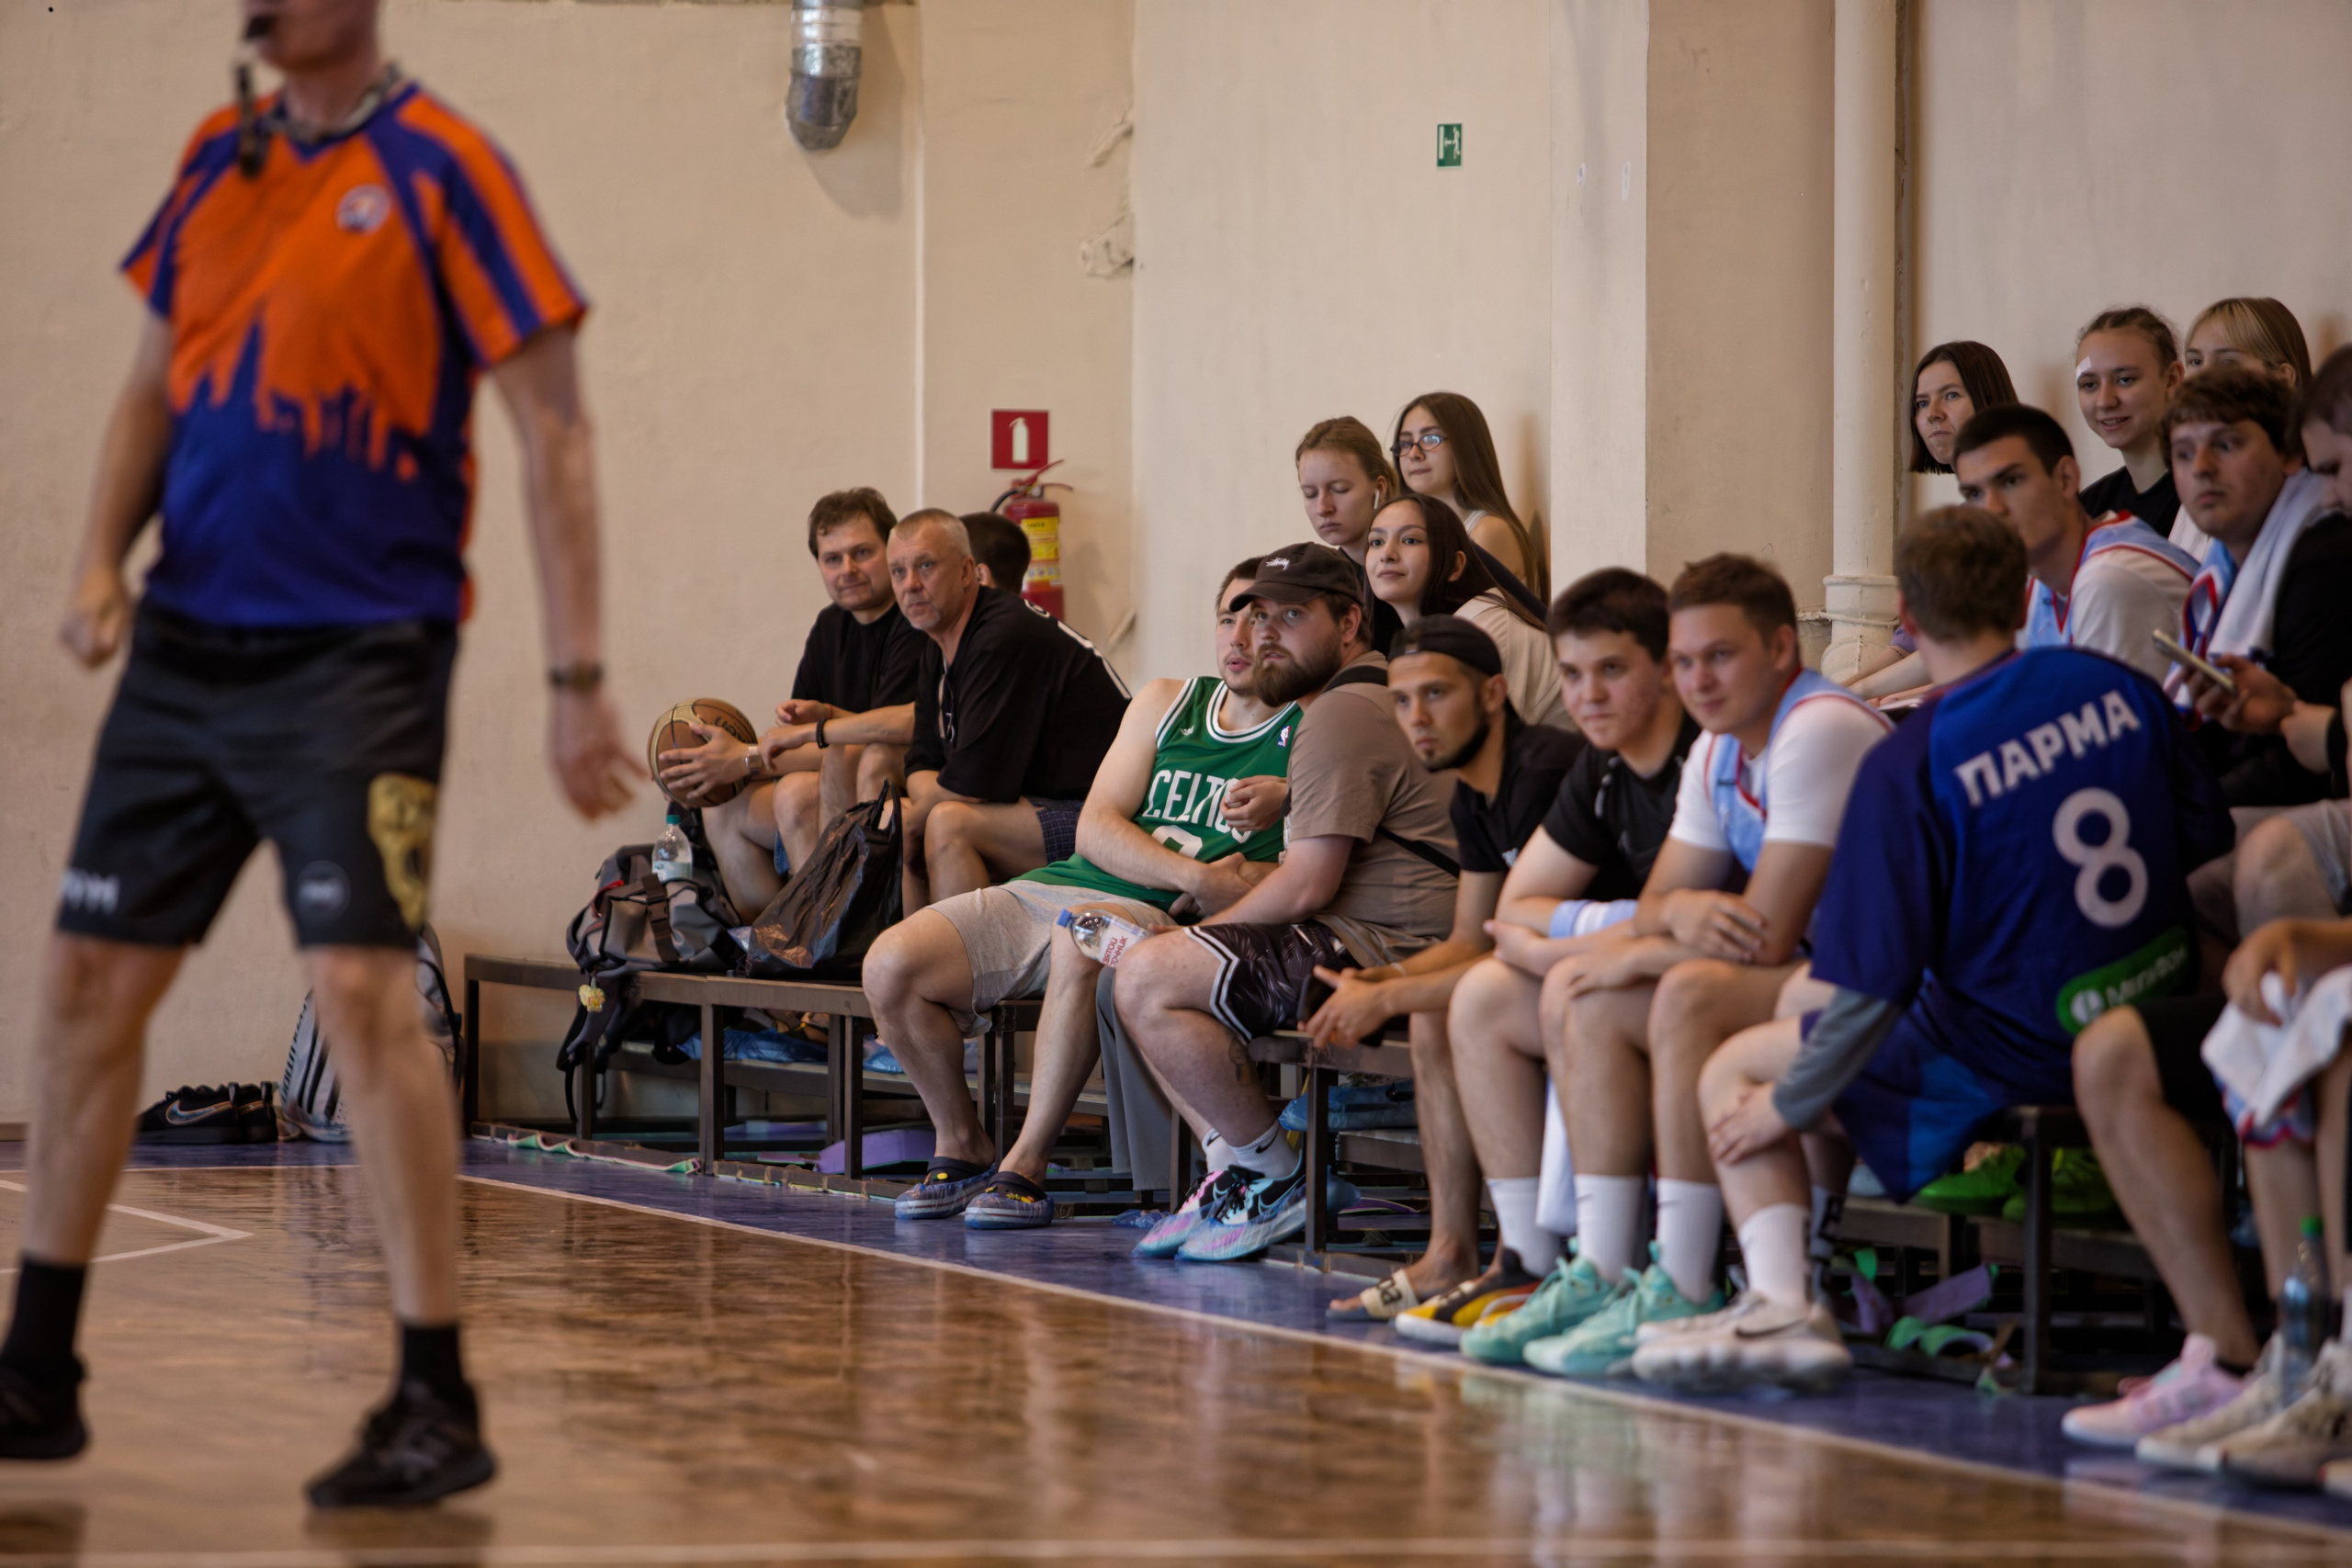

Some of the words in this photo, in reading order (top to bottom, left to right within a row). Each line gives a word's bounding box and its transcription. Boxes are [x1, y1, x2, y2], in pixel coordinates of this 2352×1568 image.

[1142, 769, 1252, 843] CELTIC
[1954, 690, 2140, 806] ПАРМА
[2052, 787, 2148, 927] 8
